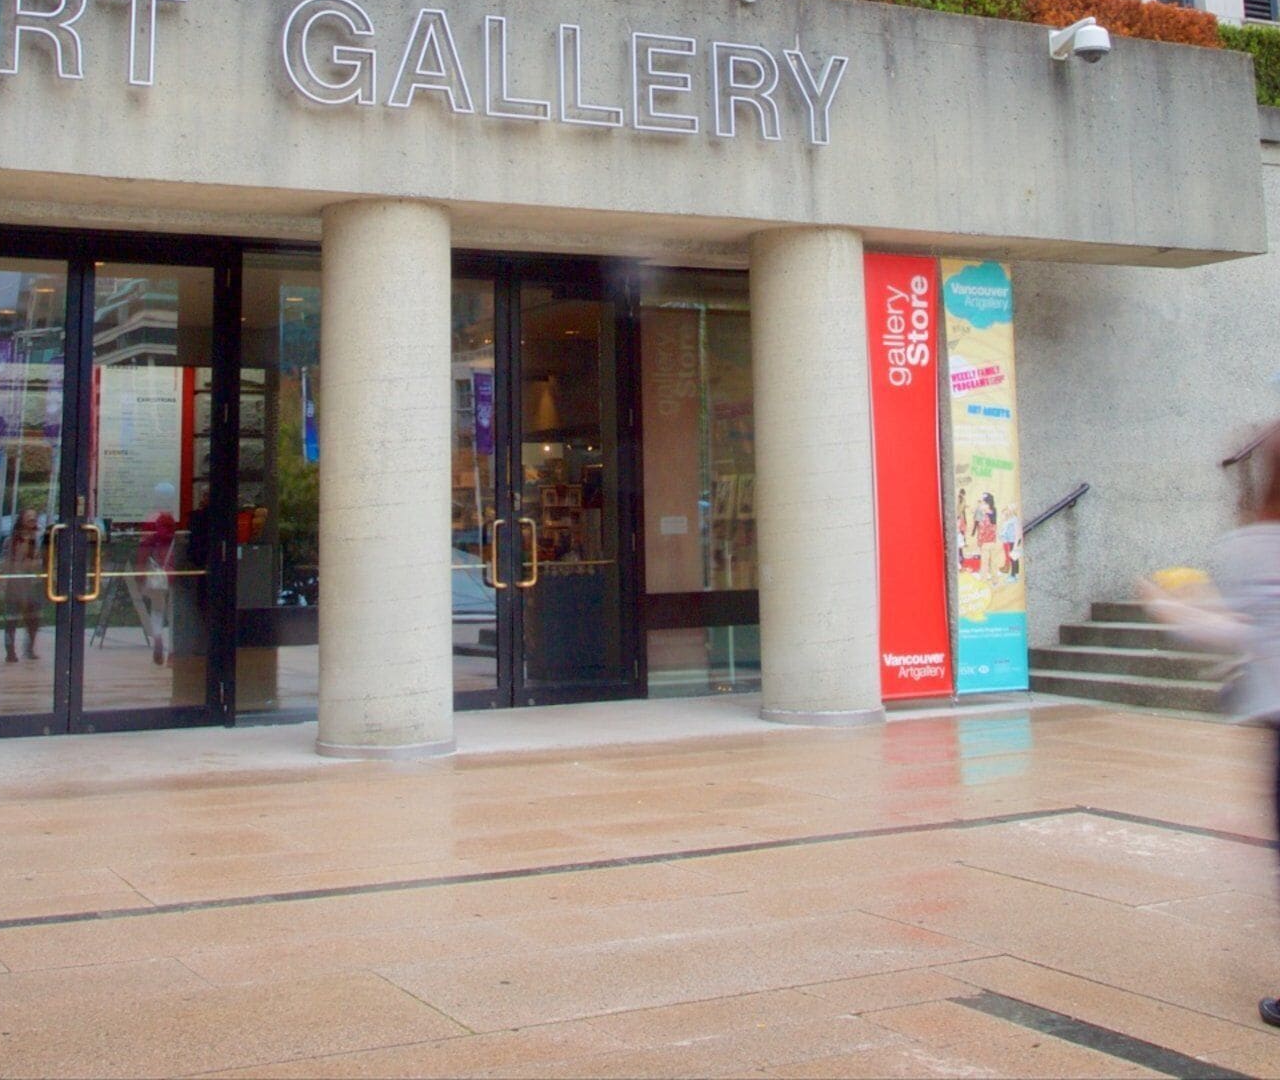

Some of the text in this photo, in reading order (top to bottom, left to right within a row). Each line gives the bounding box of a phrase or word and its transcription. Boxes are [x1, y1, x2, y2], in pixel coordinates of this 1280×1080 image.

[951, 282, 1009, 297] Vancouver
[907, 275, 929, 366] Store
[883, 285, 912, 386] gallery
[883, 653, 945, 667] Vancouver
[898, 665, 946, 681] Artgallery
